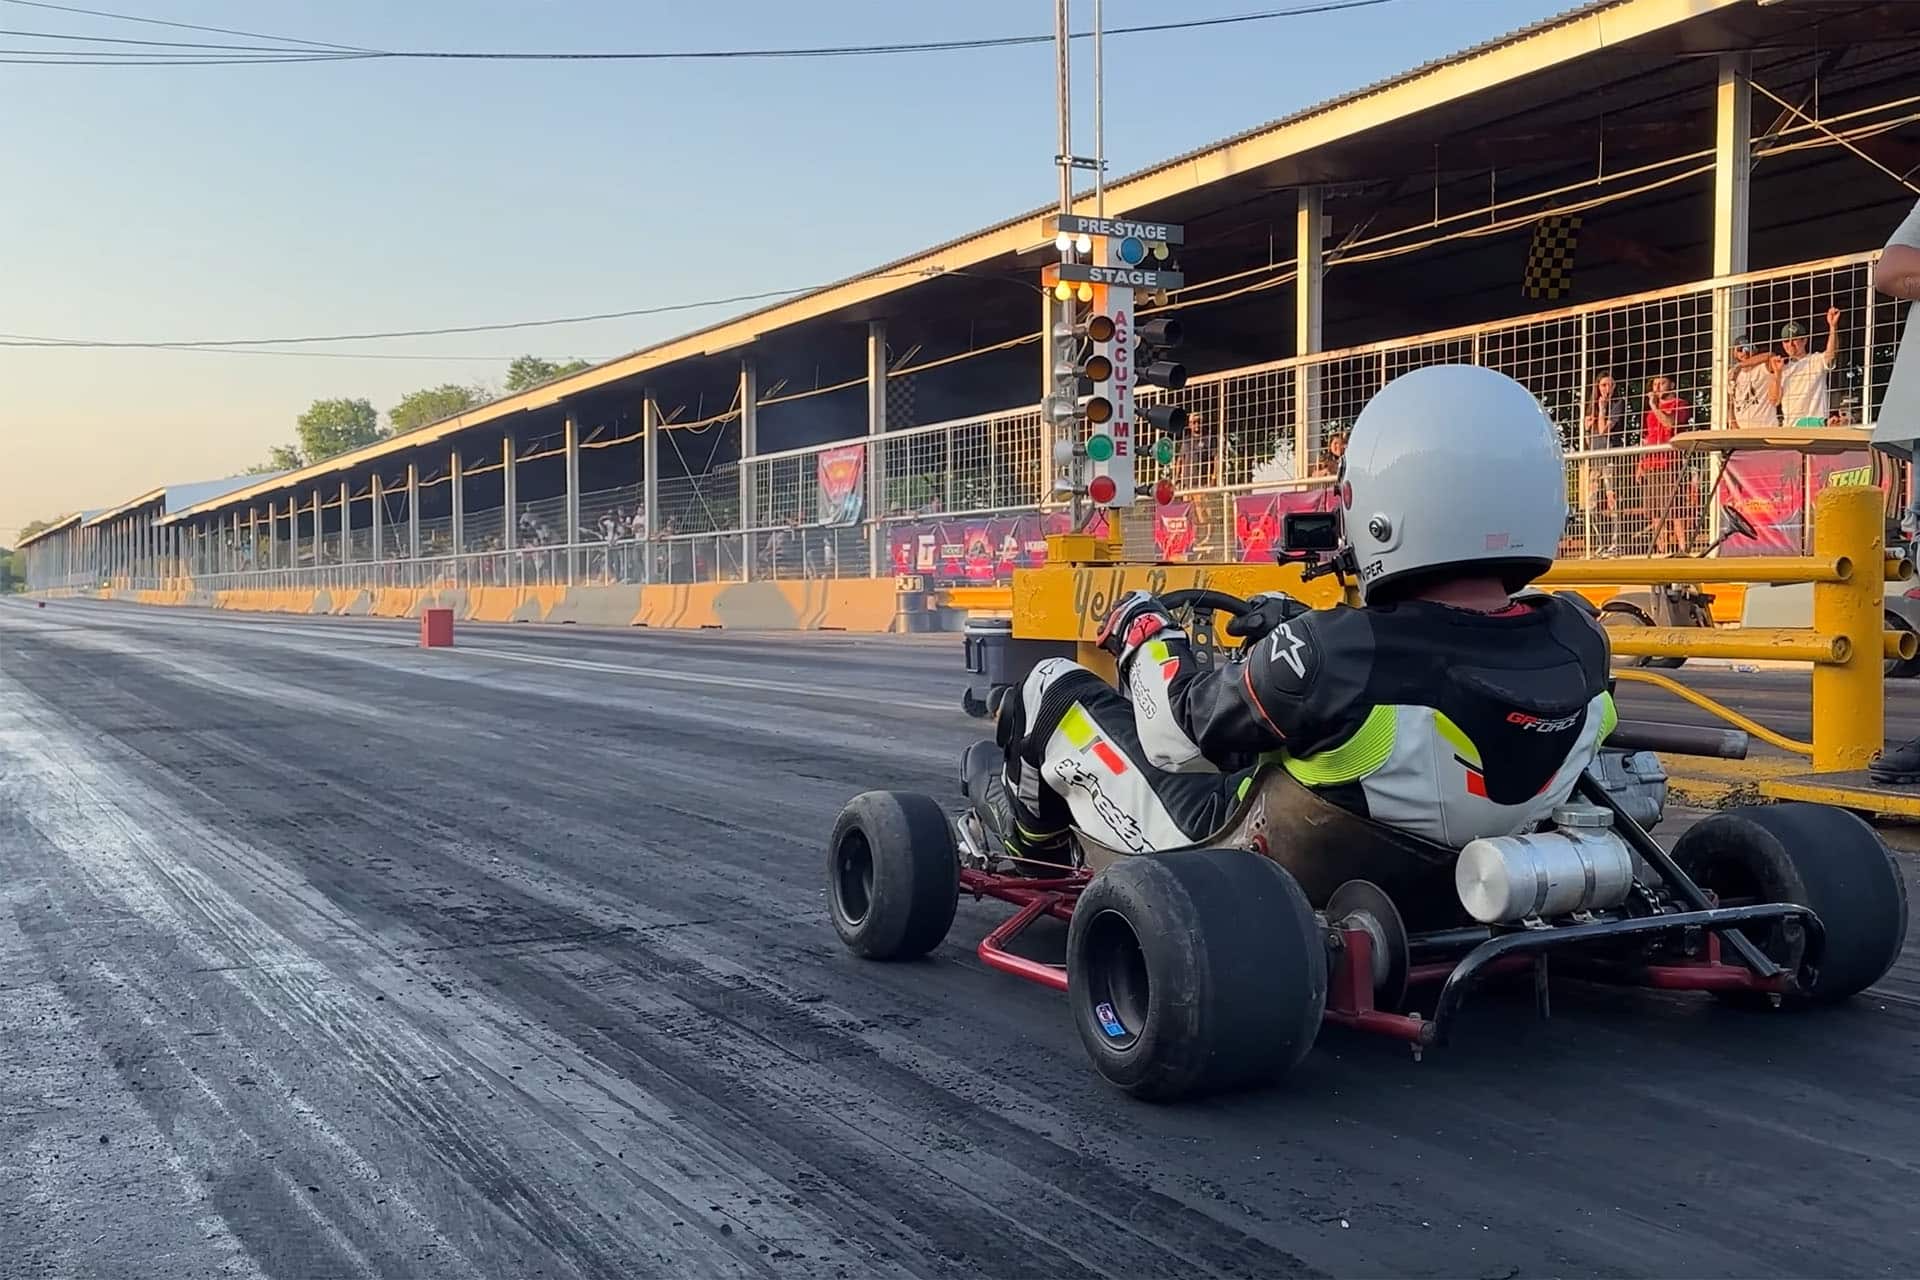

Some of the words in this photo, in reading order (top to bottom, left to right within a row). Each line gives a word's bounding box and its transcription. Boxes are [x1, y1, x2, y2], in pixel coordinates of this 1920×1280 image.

[1077, 218, 1167, 240] PRE-STAGE
[1089, 267, 1157, 286] STAGE
[1113, 310, 1129, 457] ACCUTIME
